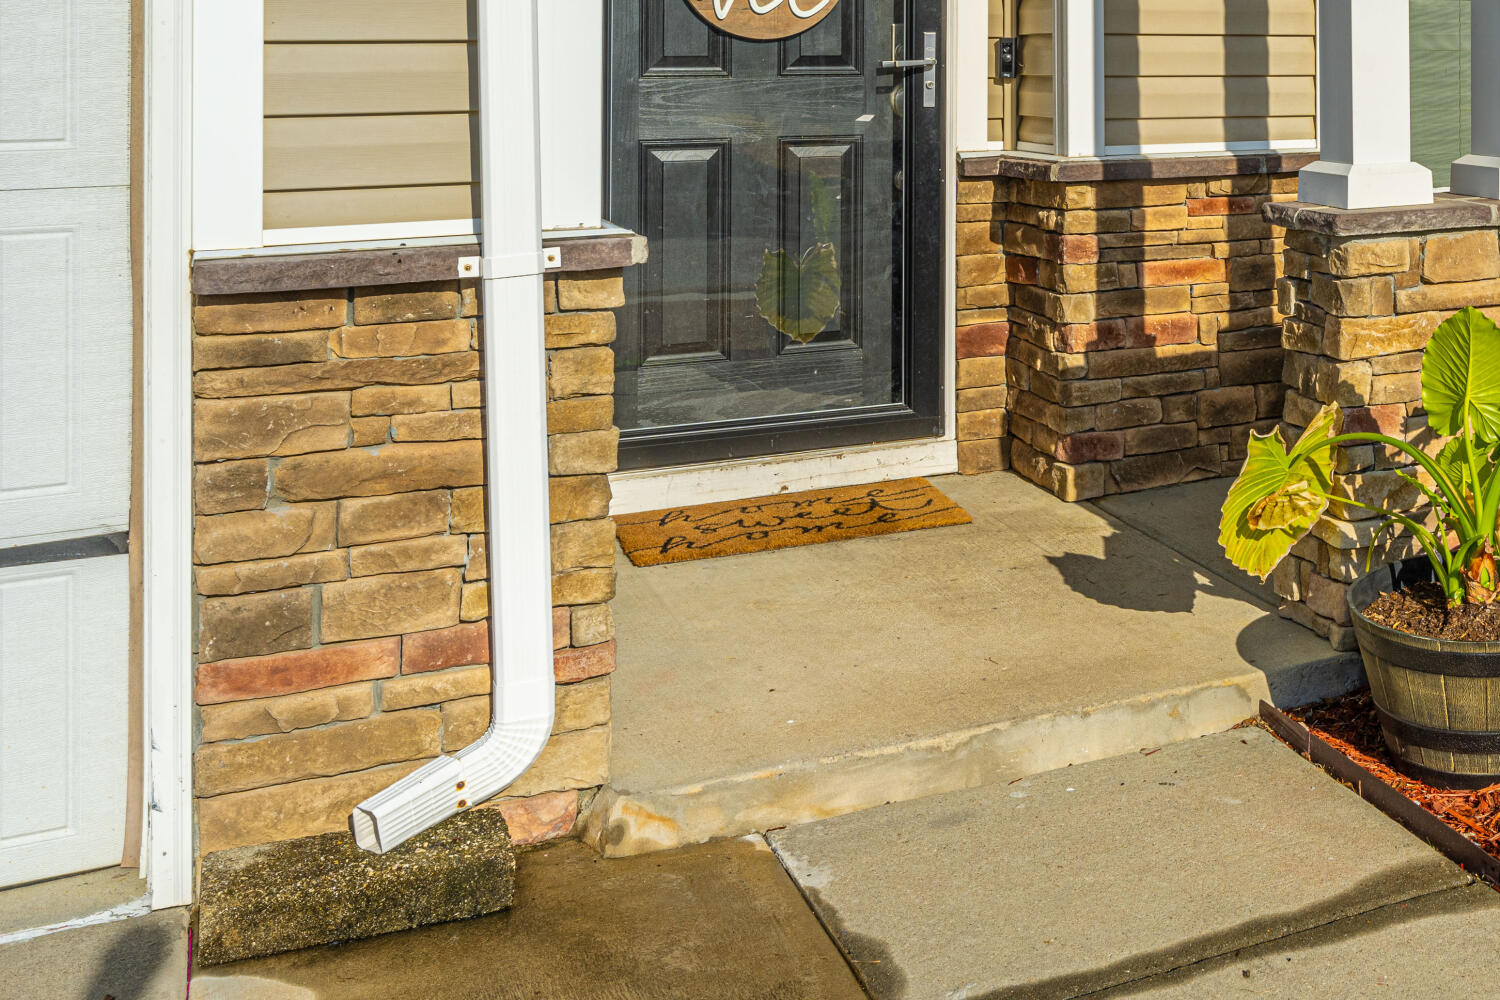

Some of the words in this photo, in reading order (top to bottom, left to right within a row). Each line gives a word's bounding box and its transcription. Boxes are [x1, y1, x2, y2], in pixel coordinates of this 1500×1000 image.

[656, 487, 888, 527] home
[694, 497, 933, 535] sweet
[658, 512, 898, 554] home
